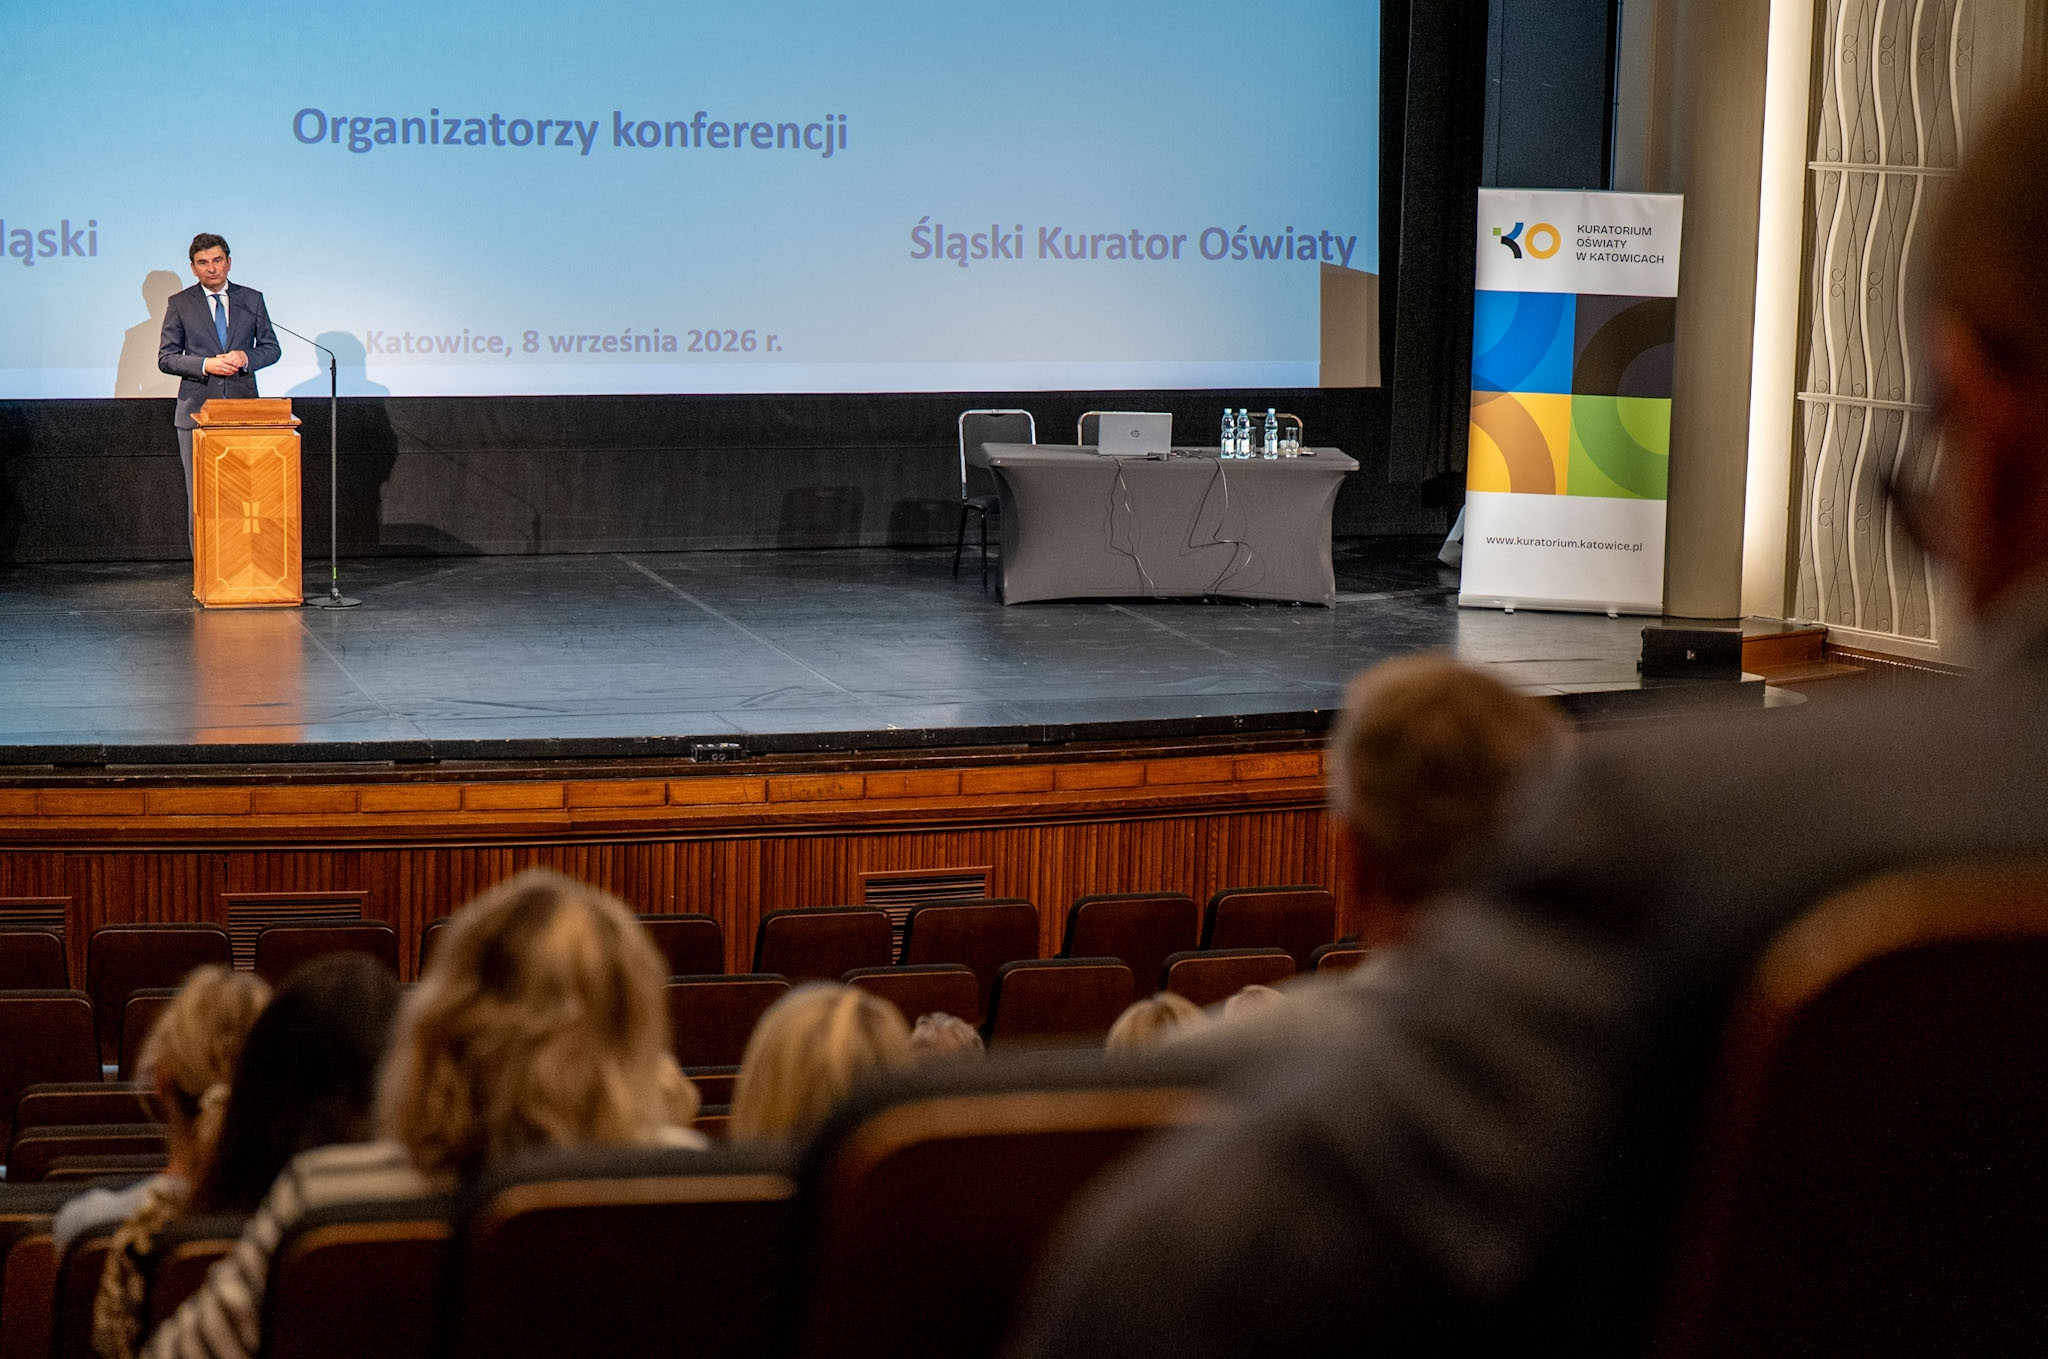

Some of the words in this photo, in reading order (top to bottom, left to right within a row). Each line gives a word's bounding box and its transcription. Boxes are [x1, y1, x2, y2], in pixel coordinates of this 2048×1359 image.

[293, 108, 599, 155] Organizatorzy
[613, 111, 847, 158] konferencji
[1577, 225, 1652, 236] KURATORIUM
[910, 216, 1023, 267] Śląski
[1039, 226, 1187, 261] Kurator
[1199, 225, 1357, 268] Oświaty
[1576, 236, 1627, 249] OŚWIATY
[1576, 252, 1587, 261] W
[1590, 253, 1665, 264] KATOWICACH
[366, 328, 513, 357] Katowice,
[522, 330, 540, 353] 8
[549, 328, 677, 353] września
[687, 329, 757, 352] 2026
[766, 333, 782, 352] r.
[1486, 536, 1643, 552] www.kuratorium.katowice.pl
